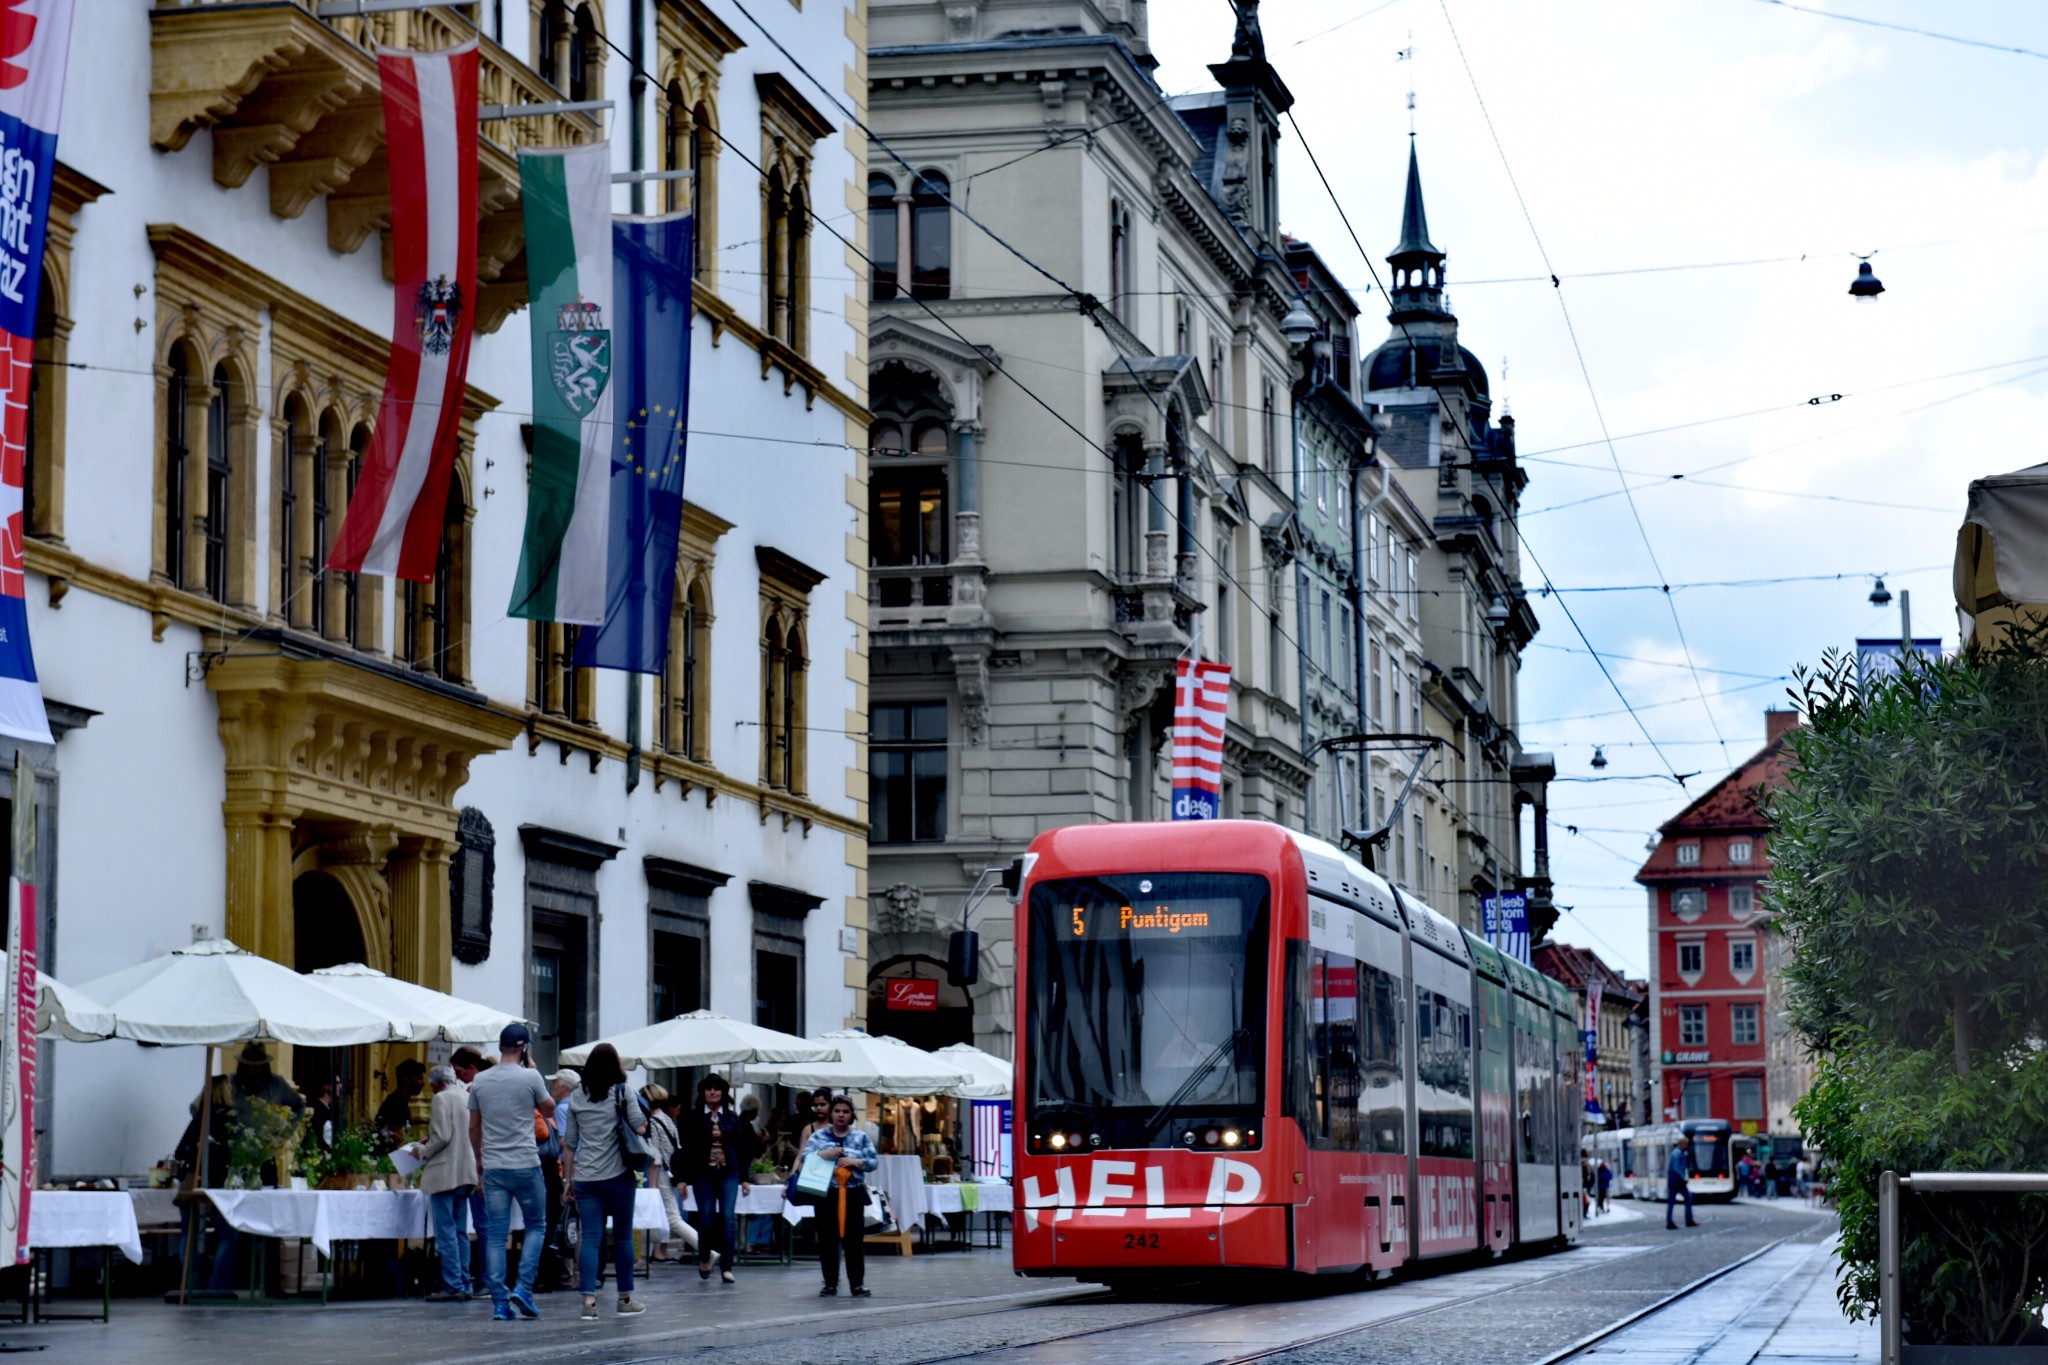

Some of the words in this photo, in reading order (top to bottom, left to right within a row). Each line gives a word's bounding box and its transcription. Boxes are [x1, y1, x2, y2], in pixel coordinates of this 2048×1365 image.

[1073, 907, 1085, 936] 5
[1120, 906, 1209, 933] Puntigam
[20, 949, 36, 1189] Silitäten
[1676, 1051, 1710, 1063] GRAWE
[1022, 1156, 1262, 1234] HELP
[1419, 1175, 1437, 1242] WE
[1438, 1175, 1464, 1240] NEED
[1124, 1233, 1160, 1249] 242
